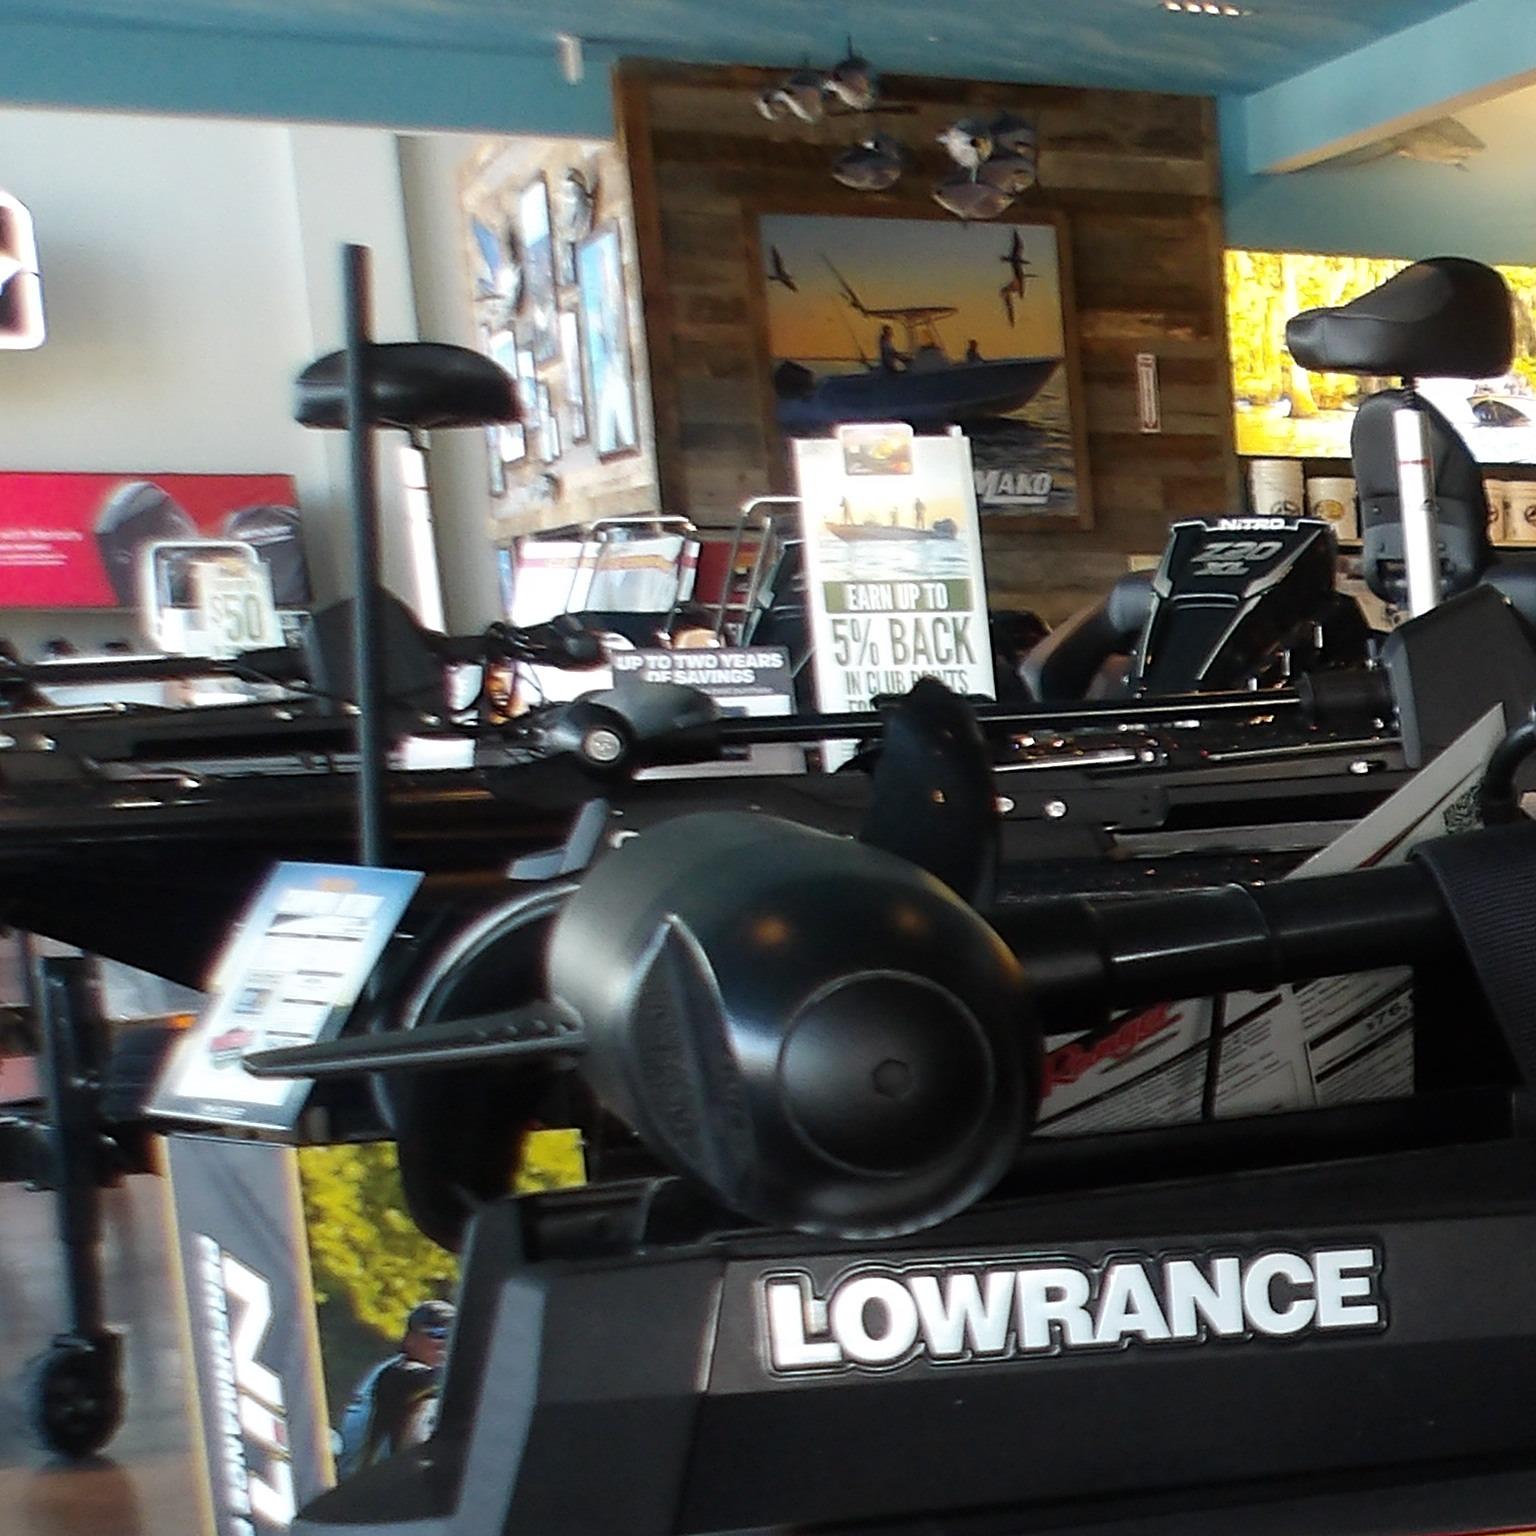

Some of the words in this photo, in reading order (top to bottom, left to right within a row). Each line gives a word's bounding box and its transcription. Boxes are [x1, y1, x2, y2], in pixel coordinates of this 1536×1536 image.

[1191, 541, 1284, 562] Z20
[846, 583, 893, 610] EARN
[898, 583, 920, 610] UP
[926, 582, 949, 610] TO
[210, 594, 264, 642] $50
[830, 618, 880, 667] 5%
[888, 616, 977, 666] BACK
[615, 654, 645, 671] UP
[645, 653, 673, 670] TO
[673, 653, 719, 670] TWO
[718, 652, 784, 669] YEARS
[644, 669, 673, 683] OF
[672, 668, 756, 685] SAVINGS
[845, 671, 863, 696] IN
[867, 671, 906, 695] CLUB
[767, 1248, 1381, 1370] LOWRANCE
[197, 1232, 253, 1517] PERFORMANCE
